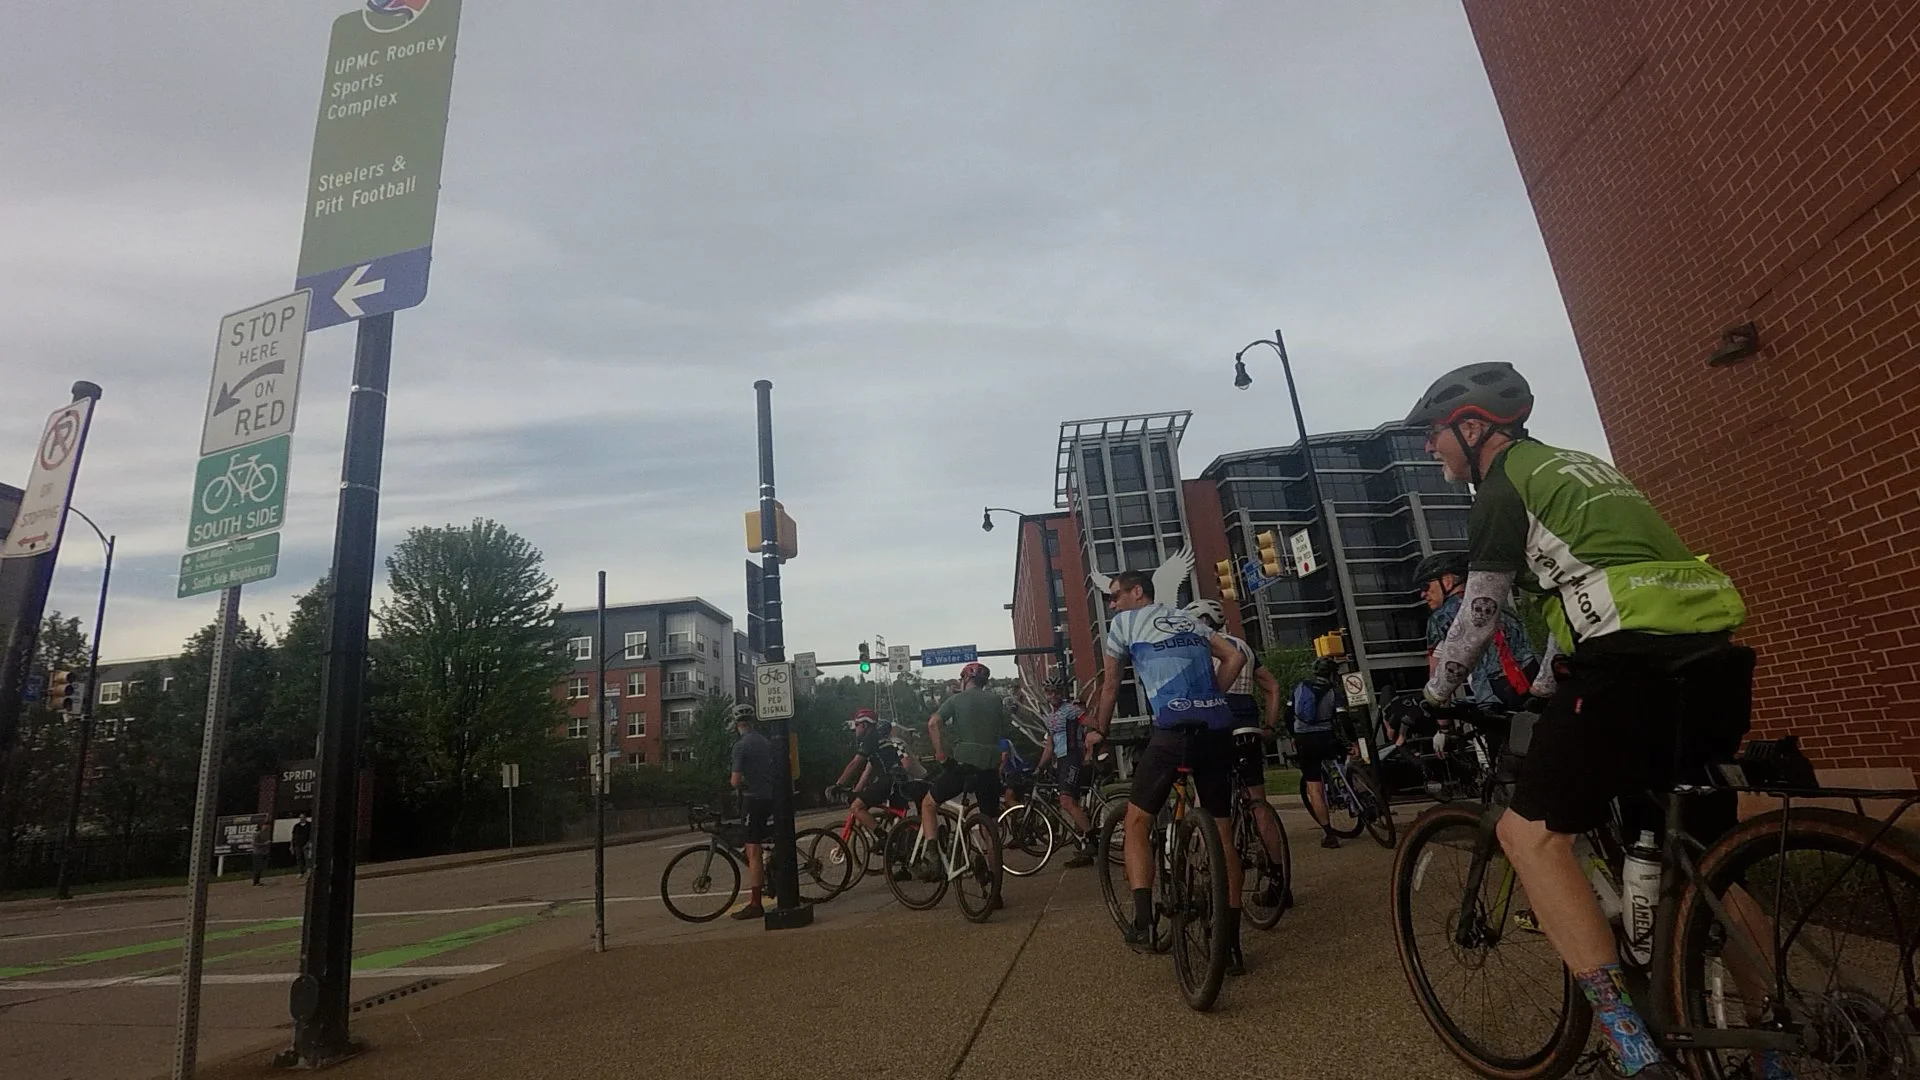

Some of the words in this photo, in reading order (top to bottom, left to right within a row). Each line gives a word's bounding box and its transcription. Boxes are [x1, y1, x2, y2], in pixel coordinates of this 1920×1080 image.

[334, 50, 380, 75] UPMC
[386, 35, 447, 62] Rooney
[331, 73, 384, 100] Sports
[327, 91, 398, 119] Complex
[318, 163, 385, 192] Steelers
[391, 155, 407, 172] &
[315, 195, 344, 218] Pitt
[351, 175, 417, 208] Football
[230, 306, 296, 347] STOP
[238, 340, 279, 366] HERE
[254, 378, 276, 399] ON
[234, 399, 285, 436] RED
[192, 514, 242, 542] SOUTH
[246, 504, 280, 529] SIDE
[1295, 534, 1305, 545] NO
[925, 656, 932, 665] S
[935, 655, 961, 664] Water
[964, 653, 974, 661] St
[767, 686, 781, 695] USE
[768, 696, 782, 704] PED
[762, 705, 788, 715] SIGNAL
[224, 825, 237, 836] FOR
[238, 824, 258, 834] LEASE
